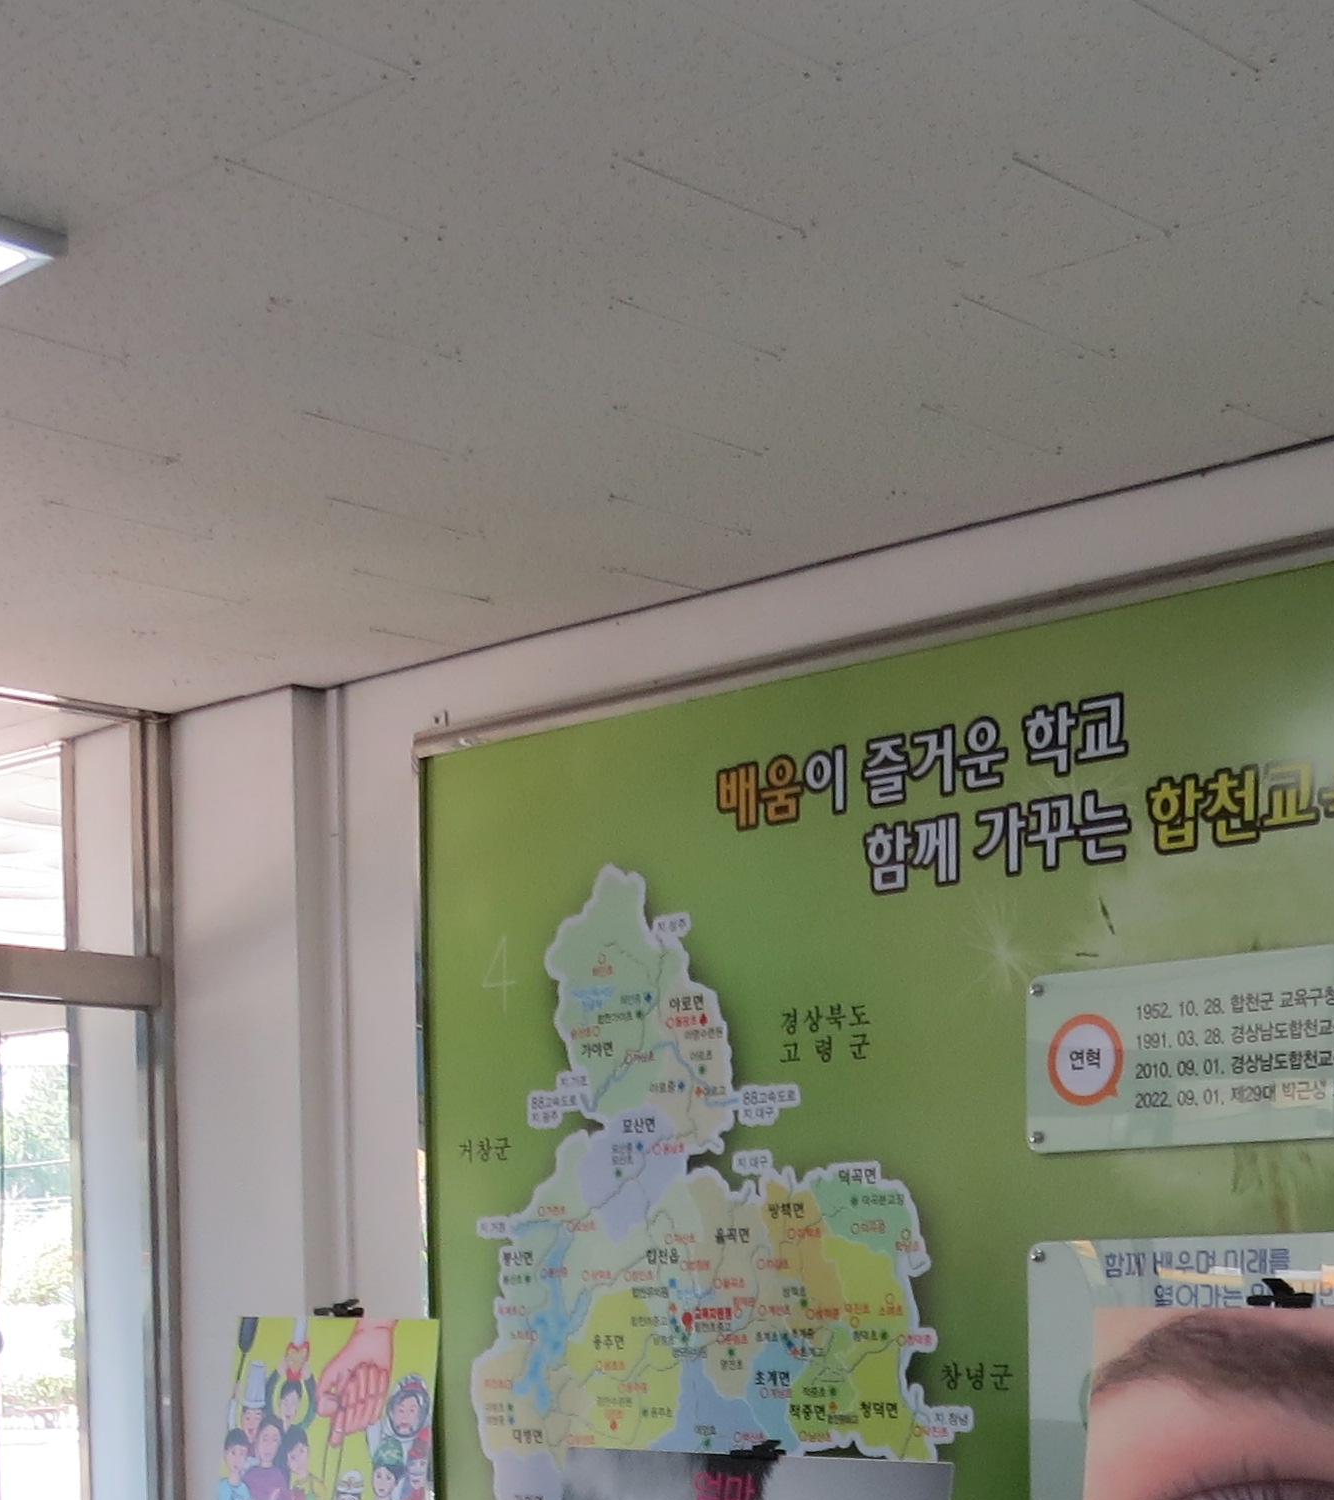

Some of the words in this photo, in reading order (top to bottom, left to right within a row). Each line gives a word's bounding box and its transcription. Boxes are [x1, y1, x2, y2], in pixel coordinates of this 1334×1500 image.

[716, 745, 848, 831] 배움이
[861, 718, 1007, 805] 즐거운
[1024, 692, 1127, 776] 학교
[864, 821, 961, 896] 함께
[975, 791, 1131, 876] 가꾸는
[669, 994, 704, 1011] 야로면
[1136, 1004, 1173, 1021] 1952.
[1178, 1000, 1200, 1017] 10.
[1203, 998, 1225, 1015] 28.
[1230, 993, 1275, 1015] 합천군
[780, 1003, 871, 1035] 경상북도
[1136, 1033, 1173, 1050] 1991.
[1176, 1030, 1199, 1047] 03.
[1203, 1027, 1225, 1044] 28.
[581, 1041, 614, 1058] 가야면
[779, 1033, 871, 1063] 고령군
[1068, 1047, 1102, 1071] 연혁
[1135, 1062, 1173, 1080] 2010.
[1176, 1060, 1199, 1077] 09.
[1203, 1059, 1225, 1075] 01.
[742, 1090, 796, 1105] 88고속도로
[1135, 1091, 1173, 1109] 2022.
[1176, 1090, 1199, 1107] 09.
[1203, 1089, 1225, 1106] 01.
[1230, 1081, 1277, 1104] 제29대
[622, 1118, 656, 1134] 묘산면
[459, 1137, 511, 1162] 거창군
[838, 1167, 878, 1186] 덕곡면
[768, 1201, 805, 1219] 쌍책면
[715, 1227, 750, 1245] 율곡면
[502, 1251, 534, 1267] 봉산면
[646, 1248, 681, 1265] 합천읍
[1104, 1251, 1147, 1279] 함께
[1152, 1249, 1217, 1276] 배우며
[1223, 1247, 1291, 1276] 미래를
[1154, 1284, 1244, 1308] 열어가는
[593, 1334, 625, 1351] 용주면
[754, 1370, 791, 1386] 초계면
[940, 1362, 1014, 1391] 창녕군
[789, 1404, 826, 1422] 적중면
[859, 1401, 898, 1419] 청덕면
[949, 1412, 968, 1426] 창녕
[512, 1428, 544, 1444] 대병면
